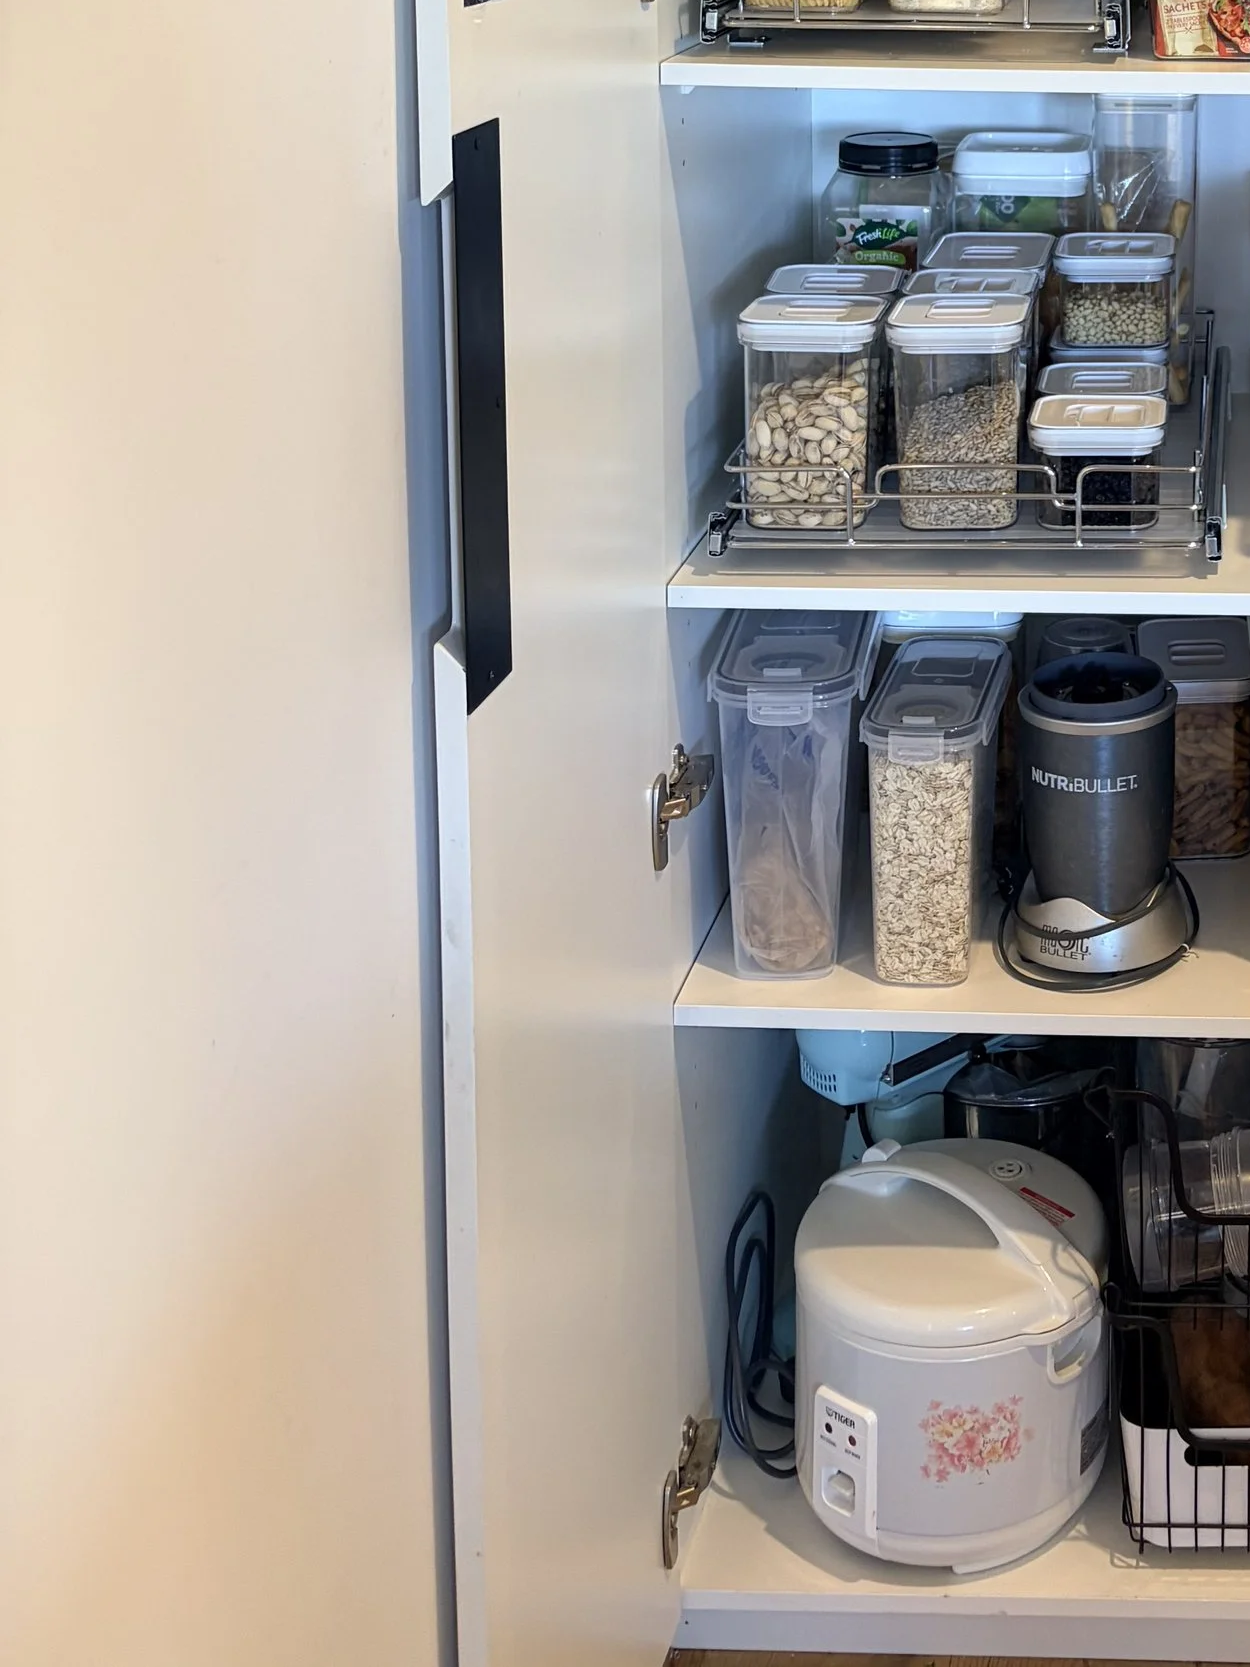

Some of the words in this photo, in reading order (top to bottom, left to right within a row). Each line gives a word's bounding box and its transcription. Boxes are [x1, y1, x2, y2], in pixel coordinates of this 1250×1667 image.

[1163, 1, 1207, 14] SACHETS
[856, 228, 881, 245] Fresh
[881, 227, 900, 240] Life
[855, 251, 899, 262] Organic
[1040, 945, 1087, 961] BULLET
[832, 1410, 856, 1429] TIGER
